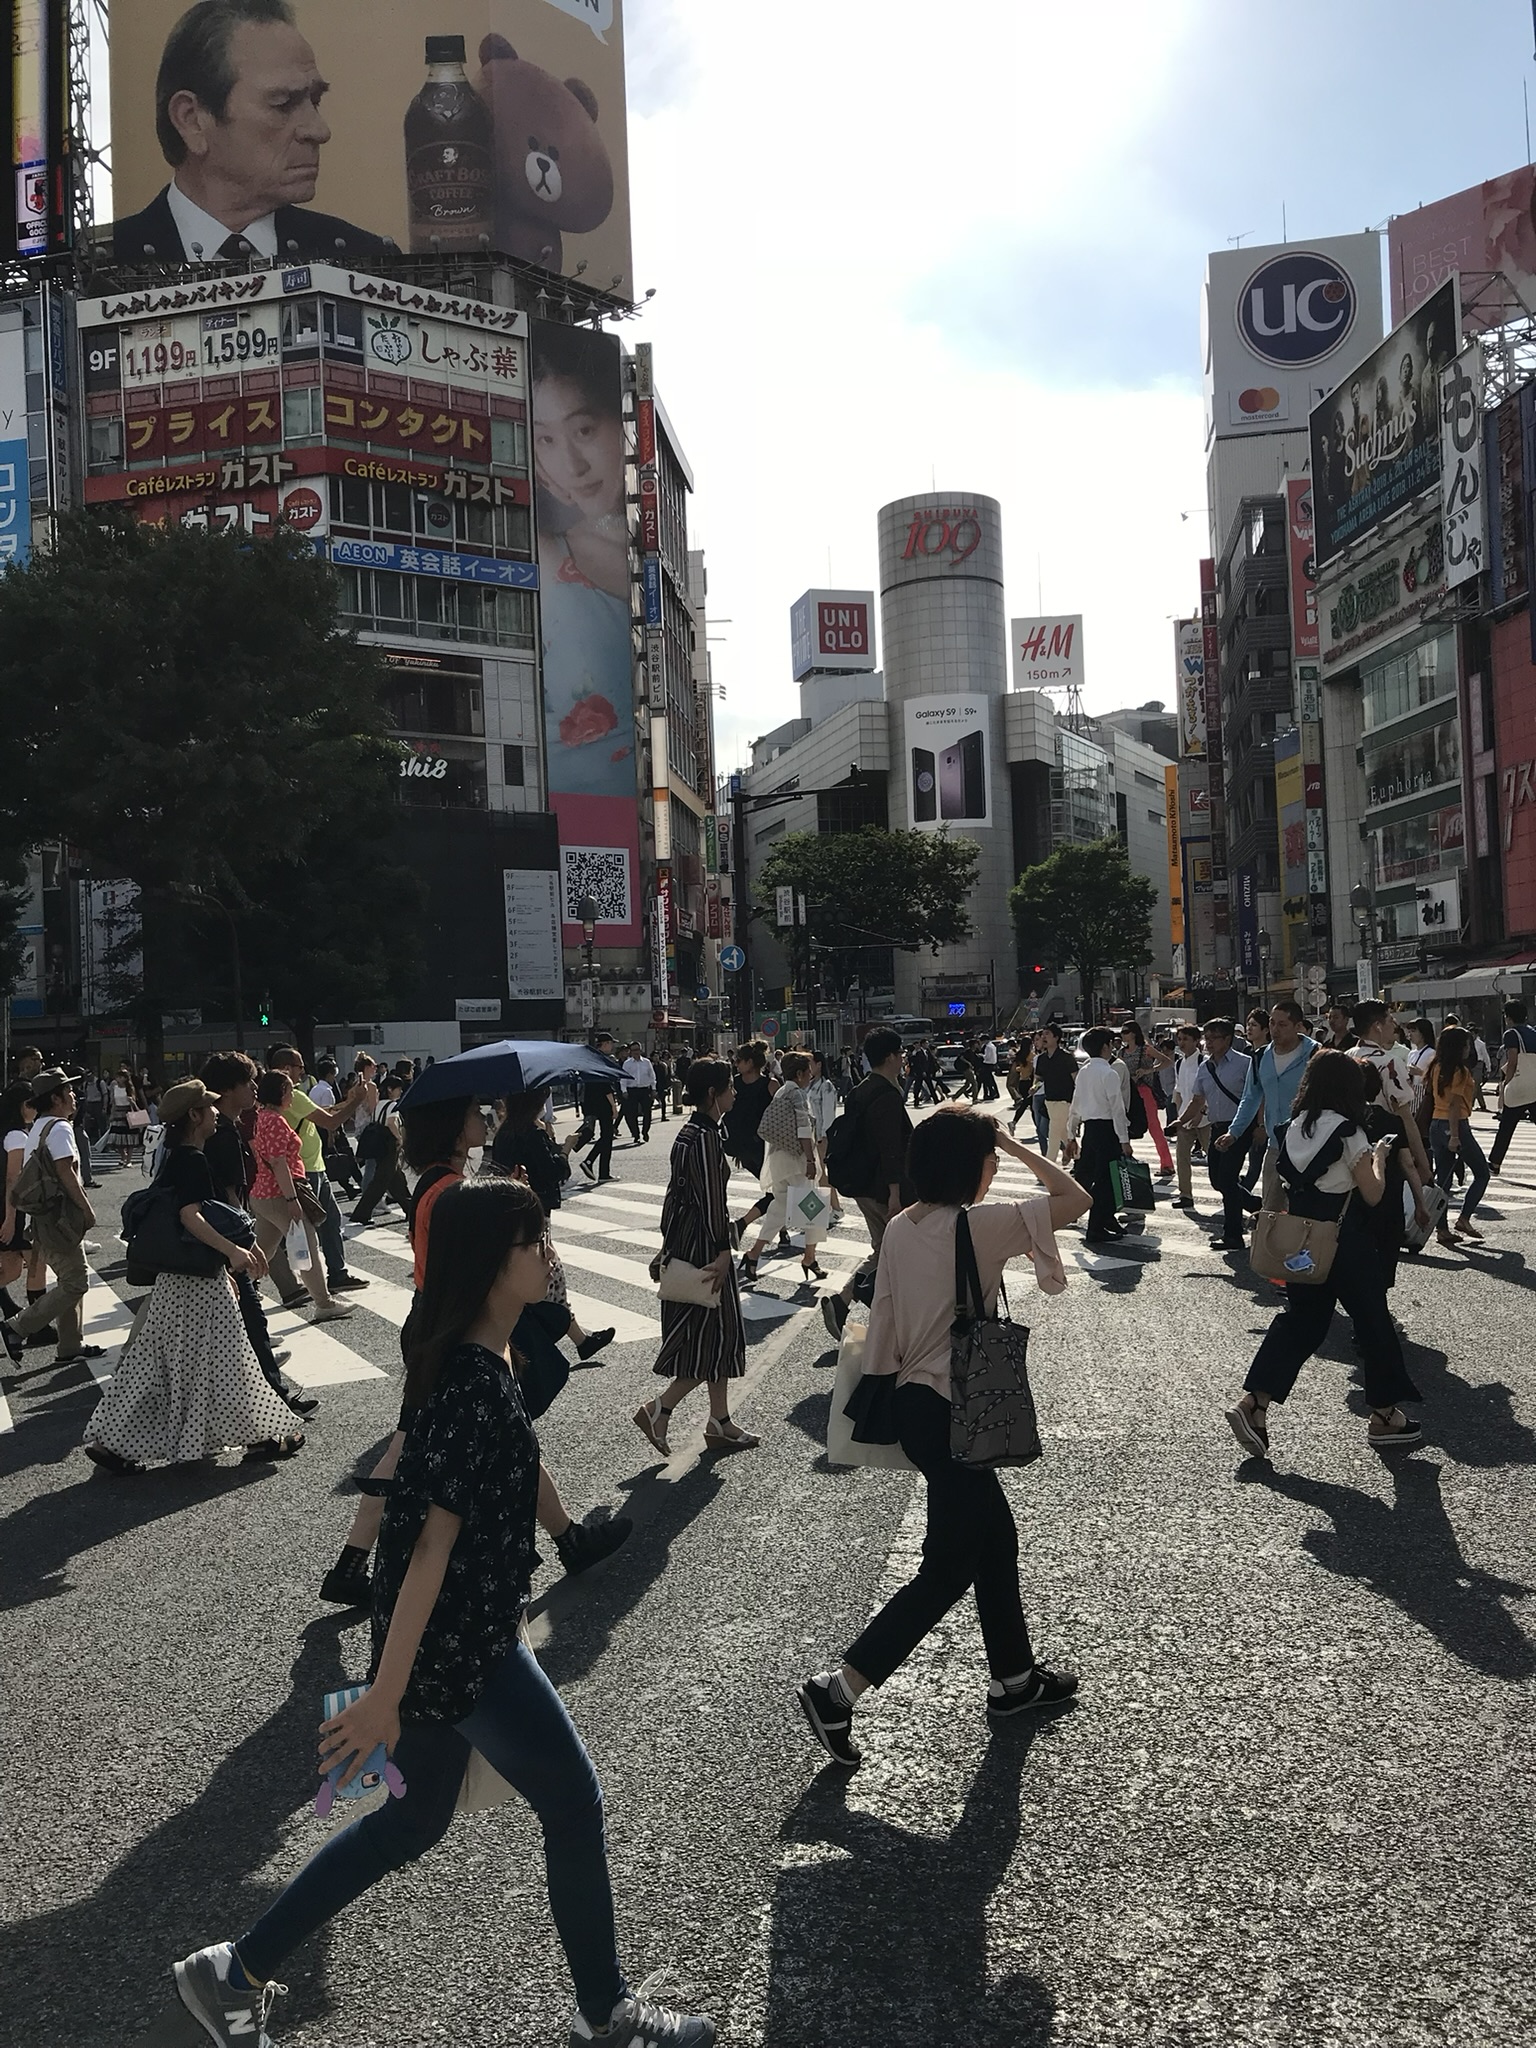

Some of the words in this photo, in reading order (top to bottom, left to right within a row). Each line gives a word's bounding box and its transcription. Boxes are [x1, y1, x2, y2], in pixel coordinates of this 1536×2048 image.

[429, 204, 476, 218] Brown
[1412, 236, 1471, 275] BEST
[101, 274, 266, 319] しゃぶしゃぶバイキング
[348, 274, 519, 329] しゃぶしゃぶバイキング
[89, 348, 117, 373] 9F
[422, 330, 518, 380] しゃぶ葉
[127, 399, 276, 451] プライス
[221, 453, 294, 493] ガスト
[1443, 361, 1481, 570] もんじゃ
[443, 469, 515, 505] ガスト
[288, 506, 319, 519] ガスト
[645, 509, 656, 542] ガスト
[913, 509, 979, 520] SHIBUYA
[900, 519, 982, 566] 109
[339, 543, 388, 563] AEON
[400, 549, 462, 575] 英会話
[464, 560, 535, 585] イーオン
[824, 609, 859, 628] UNI
[825, 630, 862, 651] QLO
[1020, 623, 1075, 662] H&M
[650, 644, 662, 704] 渋谷駅前ビル
[915, 709, 945, 719] Galaxy
[946, 708, 957, 716] S9
[399, 756, 449, 780] shi8
[1369, 768, 1433, 803] Euphoria
[1306, 781, 1320, 792] JTB
[1171, 819, 1179, 867] Matsumoto
[1243, 875, 1251, 908] MIZUHO
[948, 1007, 966, 1018] 109
[224, 2008, 256, 2036] N
